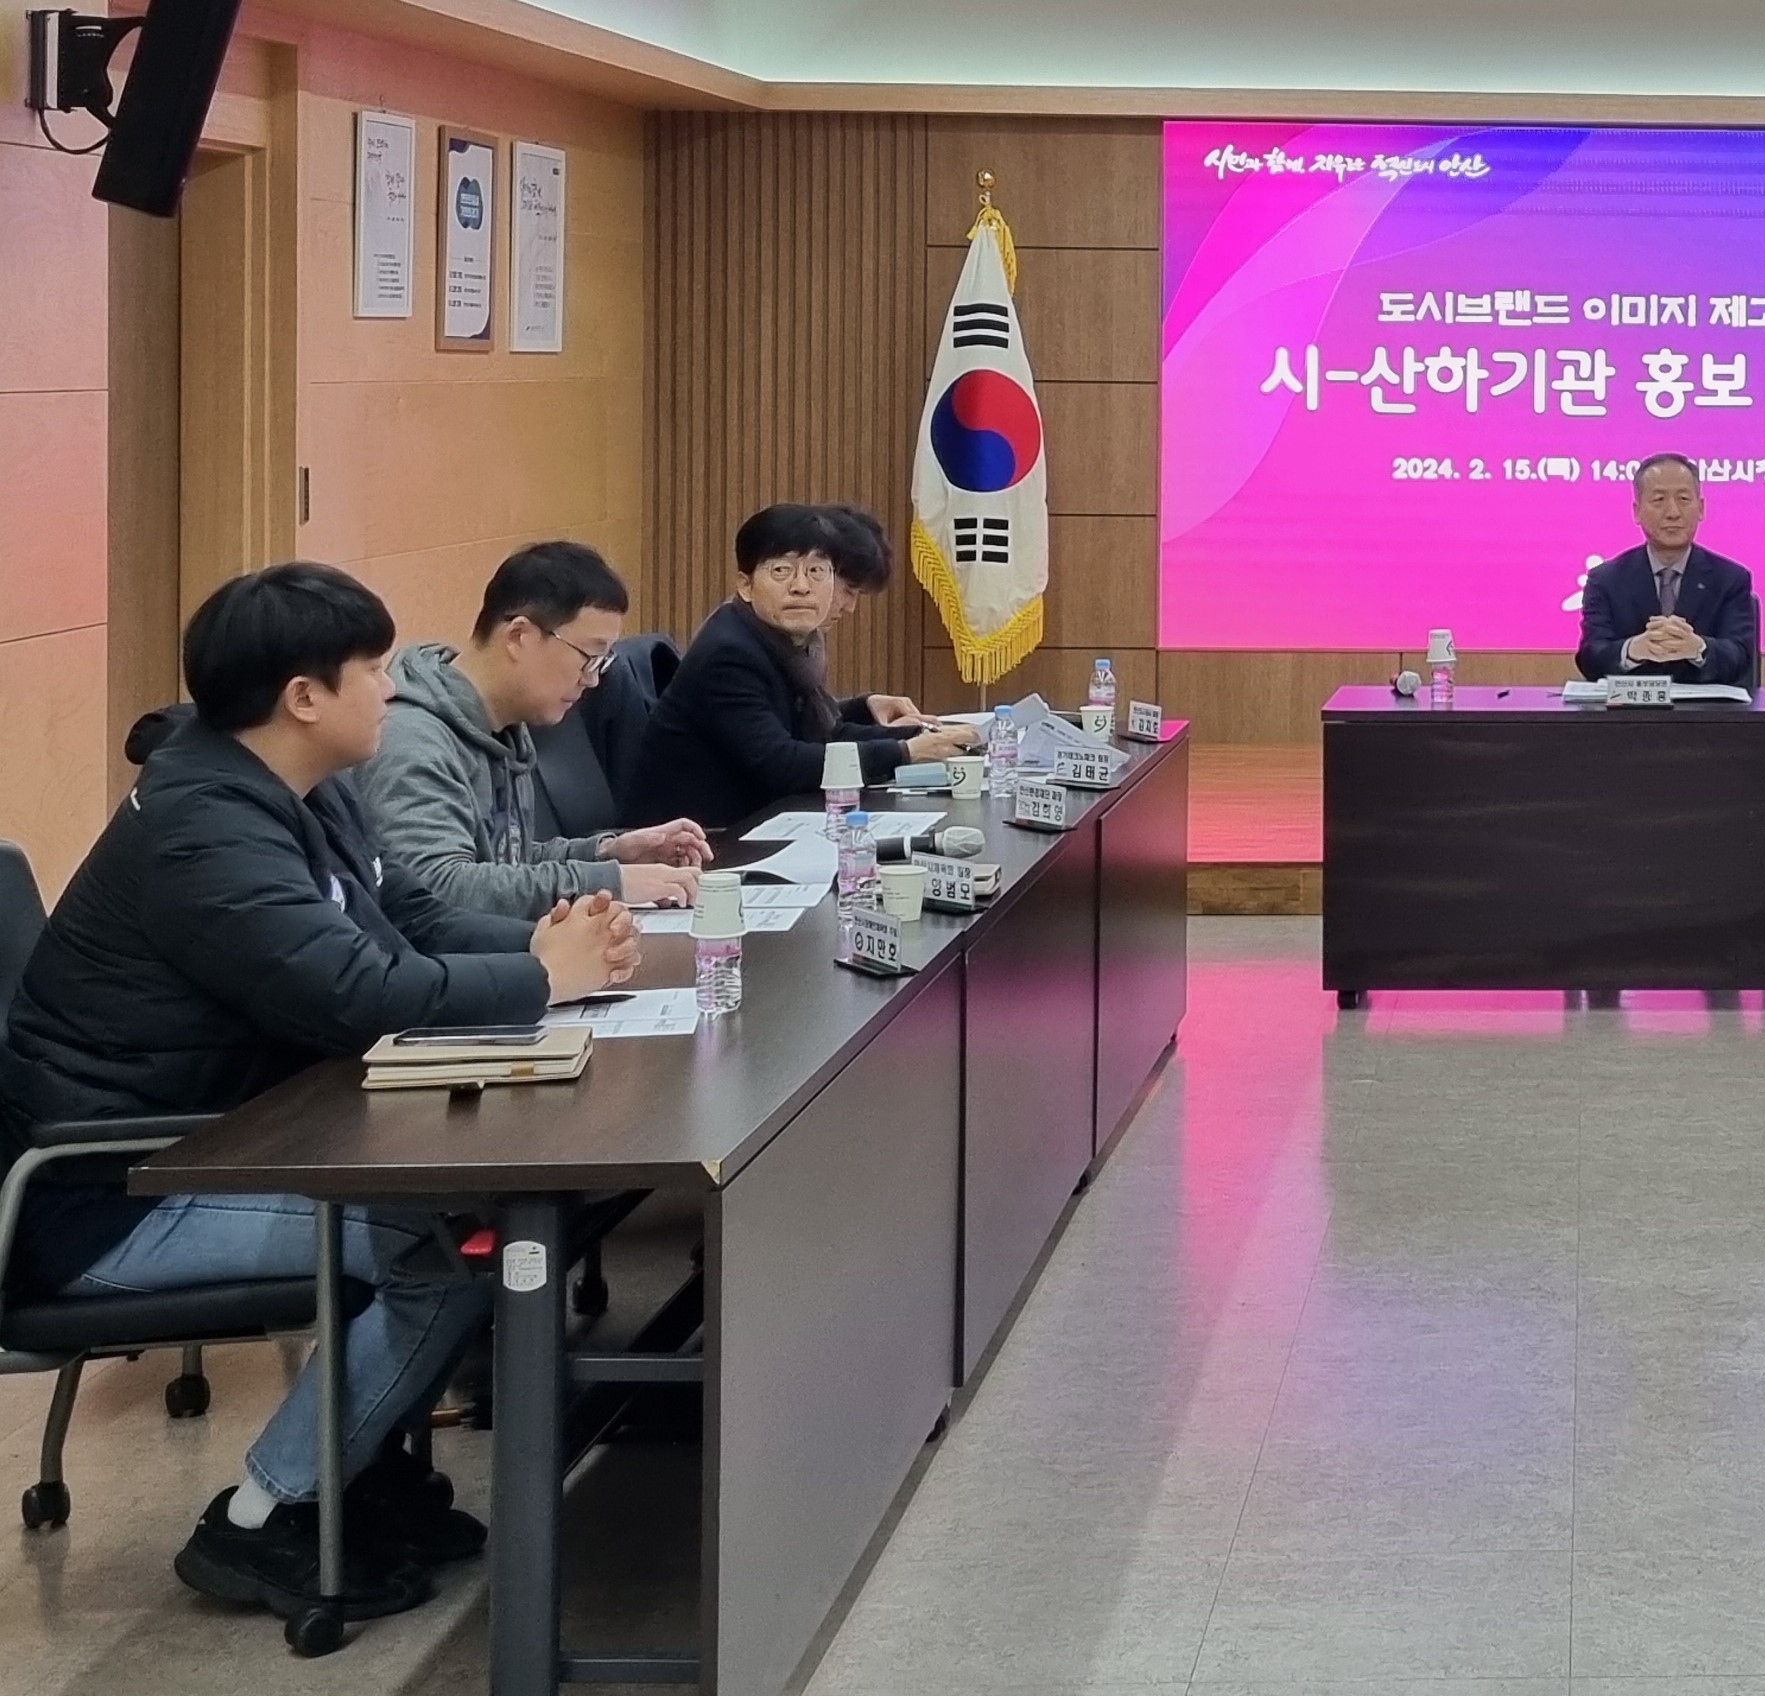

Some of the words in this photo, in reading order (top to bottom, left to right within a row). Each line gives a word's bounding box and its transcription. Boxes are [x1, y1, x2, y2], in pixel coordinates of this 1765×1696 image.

[1204, 144, 1263, 180] 시민과
[1370, 153, 1434, 182] 혁신도시
[1438, 152, 1491, 179] 안산
[1377, 291, 1571, 325] 도시브랜드
[1582, 292, 1697, 328] 이미지
[1260, 345, 1617, 418] 시-산하기관
[1634, 350, 1754, 419] 홍보
[1392, 457, 1461, 480] 2024.
[1468, 458, 1492, 480] 2.
[1072, 763, 1109, 781] 김태균
[931, 878, 971, 901] 양범모
[866, 934, 897, 962] 지만호
